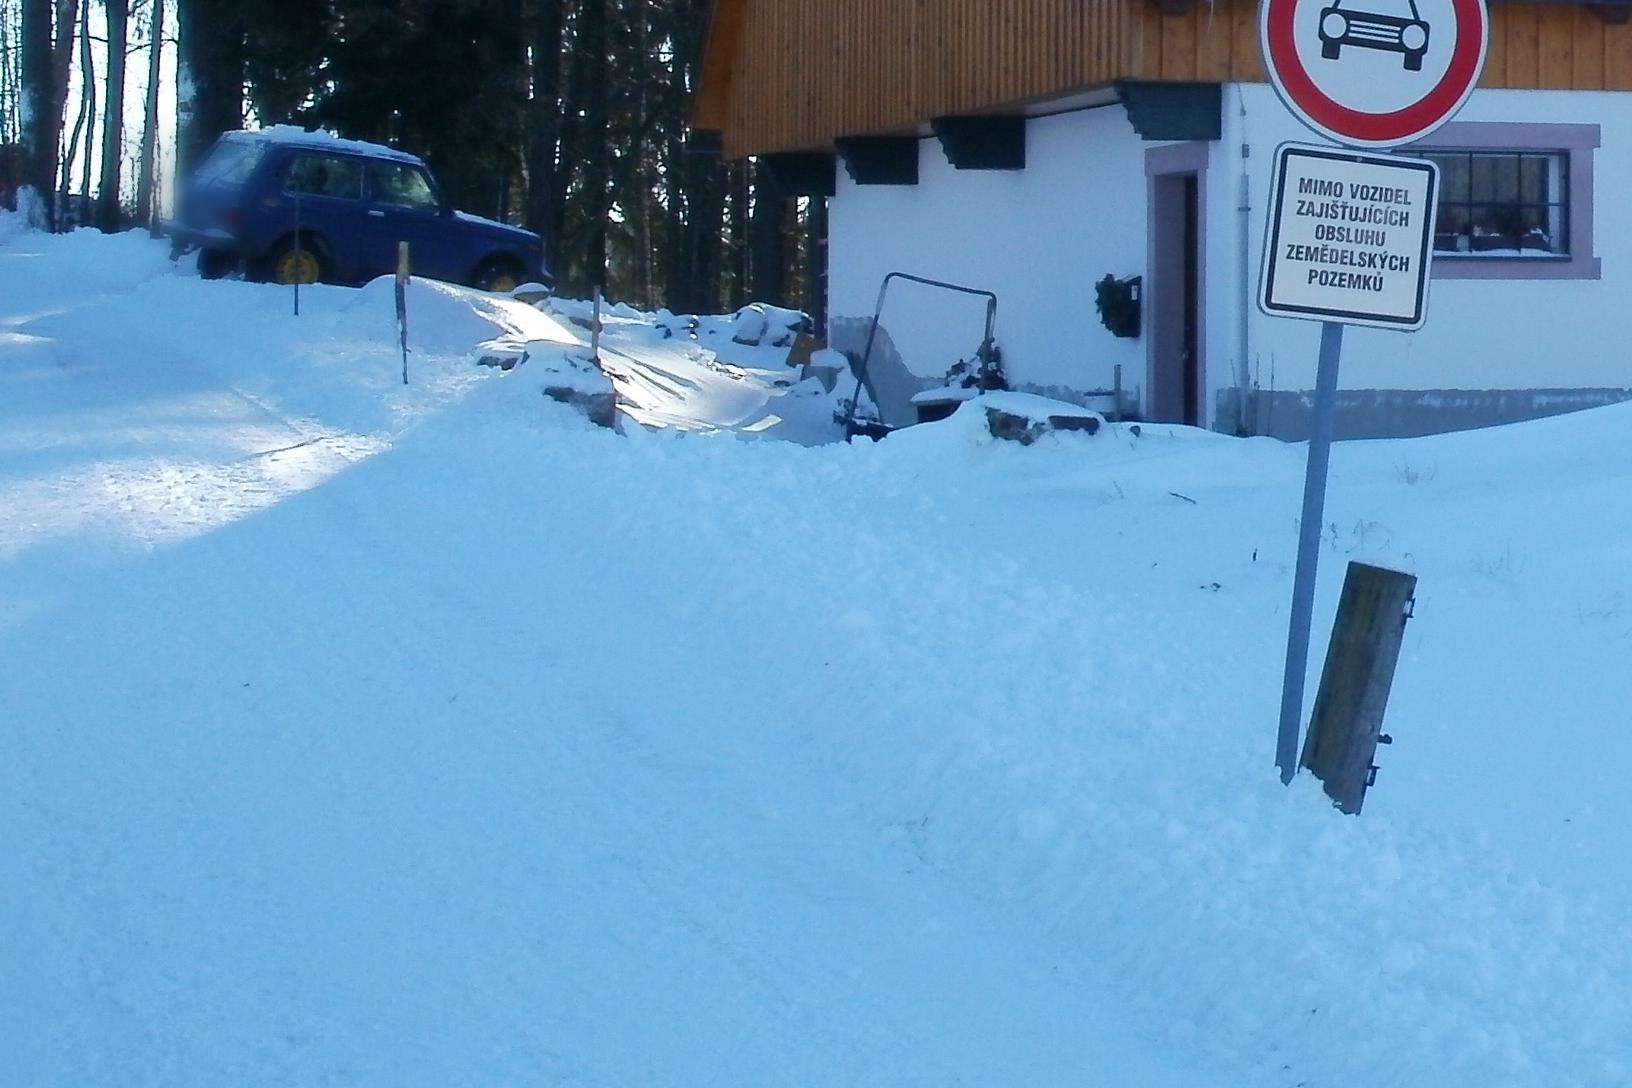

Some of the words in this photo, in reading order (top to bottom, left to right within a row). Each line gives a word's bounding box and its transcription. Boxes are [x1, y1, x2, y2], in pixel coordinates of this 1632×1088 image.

[1299, 177, 1343, 198] MIMO
[1350, 183, 1411, 205] VOZIDEL
[1297, 200, 1409, 227] ZAJIŠŤUJÍCÍCH
[1315, 224, 1386, 247] OBSLUHU
[1308, 269, 1383, 292] POZEMKŮ
